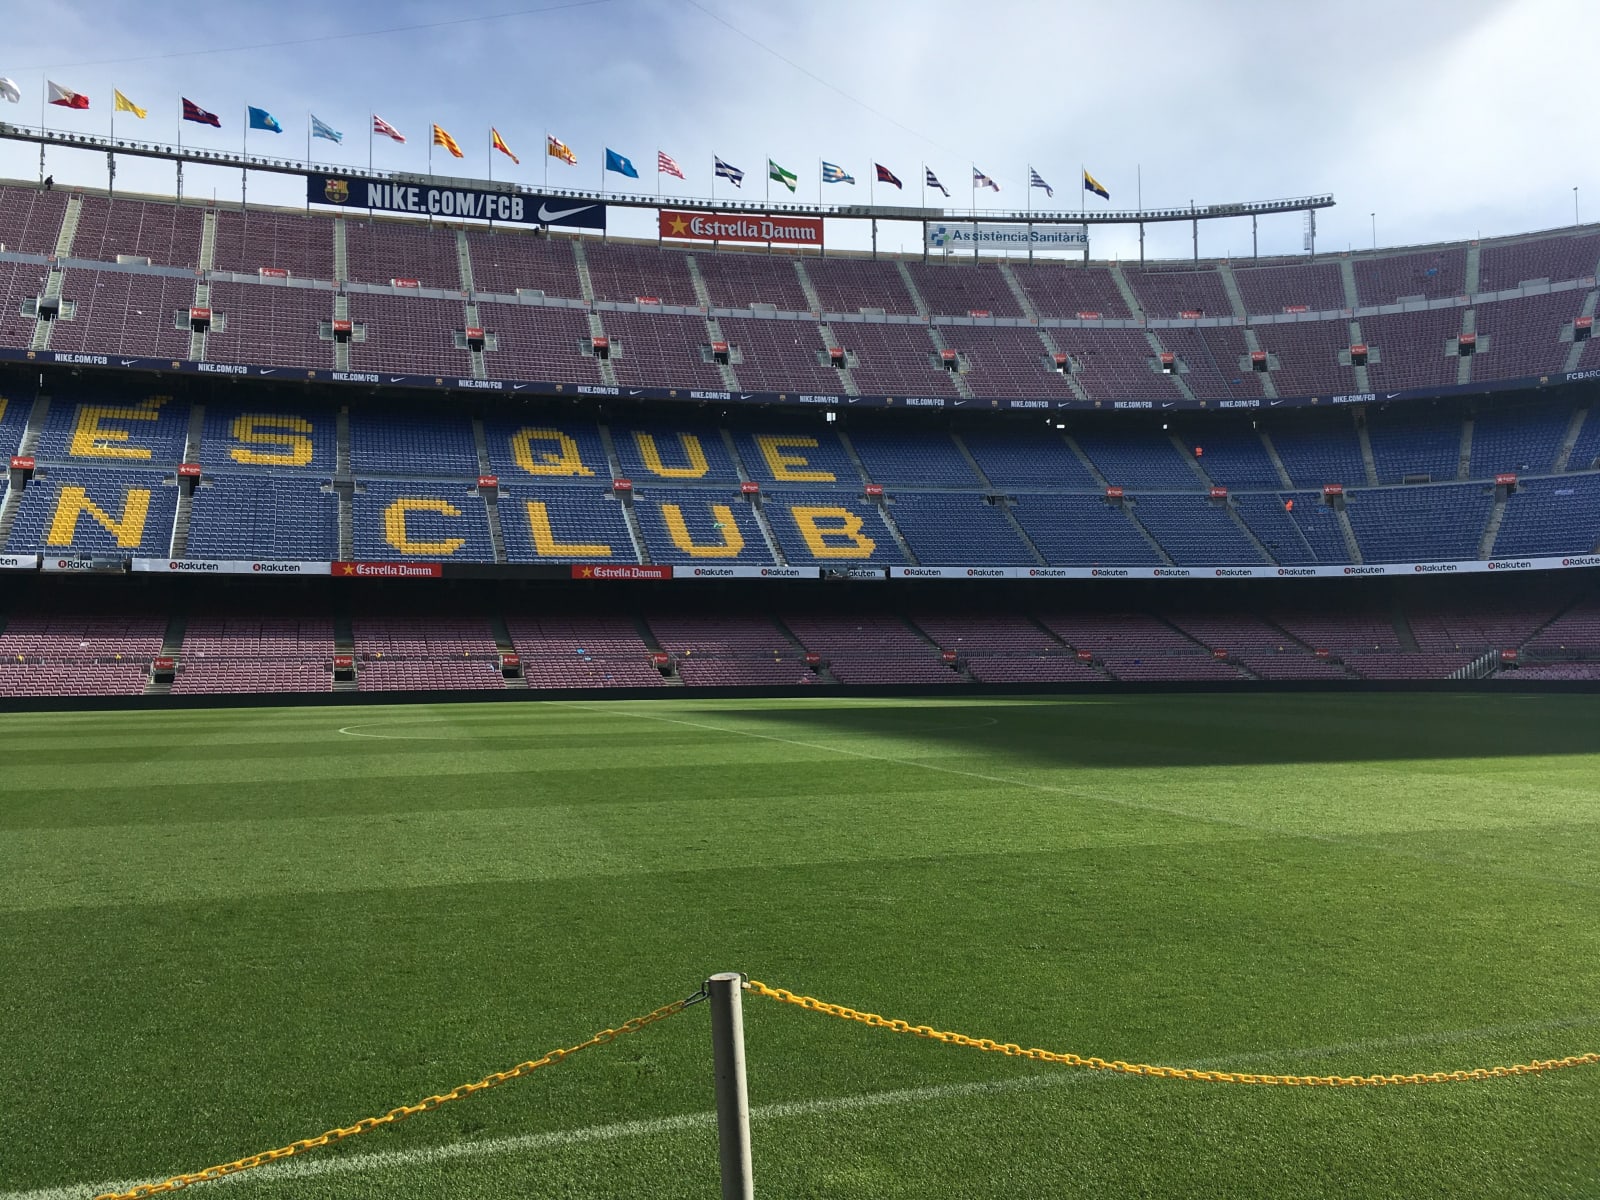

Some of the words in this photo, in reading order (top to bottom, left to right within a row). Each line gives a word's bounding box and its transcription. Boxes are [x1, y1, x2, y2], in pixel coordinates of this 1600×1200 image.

[368, 183, 524, 221] NIKE.COM/FCB
[690, 216, 758, 237] Estrella
[760, 220, 817, 240] Damm
[54, 352, 108, 365] NIKE.COM/FCB
[198, 362, 248, 375] NIKE.COM/FCB
[332, 372, 379, 383] NIKE.COM/FCB
[458, 379, 502, 390] NIKE.COM/FCB
[577, 386, 619, 396] NIKE.COM/FCB
[511, 427, 837, 482] QUE
[384, 498, 877, 559] CLUB
[178, 561, 219, 571] Rakuten
[261, 563, 300, 572] Rakuten
[356, 563, 397, 576] Estrella
[398, 564, 432, 576] Damm
[1422, 564, 1457, 573] Rakuten
[1495, 561, 1532, 570] Rakuten
[593, 567, 631, 578] Estrella
[631, 567, 662, 579] Damm
[701, 568, 733, 576] Rakuten
[768, 568, 799, 577] Rakuten
[910, 568, 941, 577] Rakuten
[974, 568, 1004, 577] Rakuten
[1036, 568, 1066, 577] Rakuten
[1097, 568, 1128, 577] Rakuten
[1160, 568, 1190, 577] Rakuten
[1222, 568, 1252, 577] Rakuten
[1284, 567, 1316, 576] Rakuten
[1351, 566, 1385, 575] Rakuten
